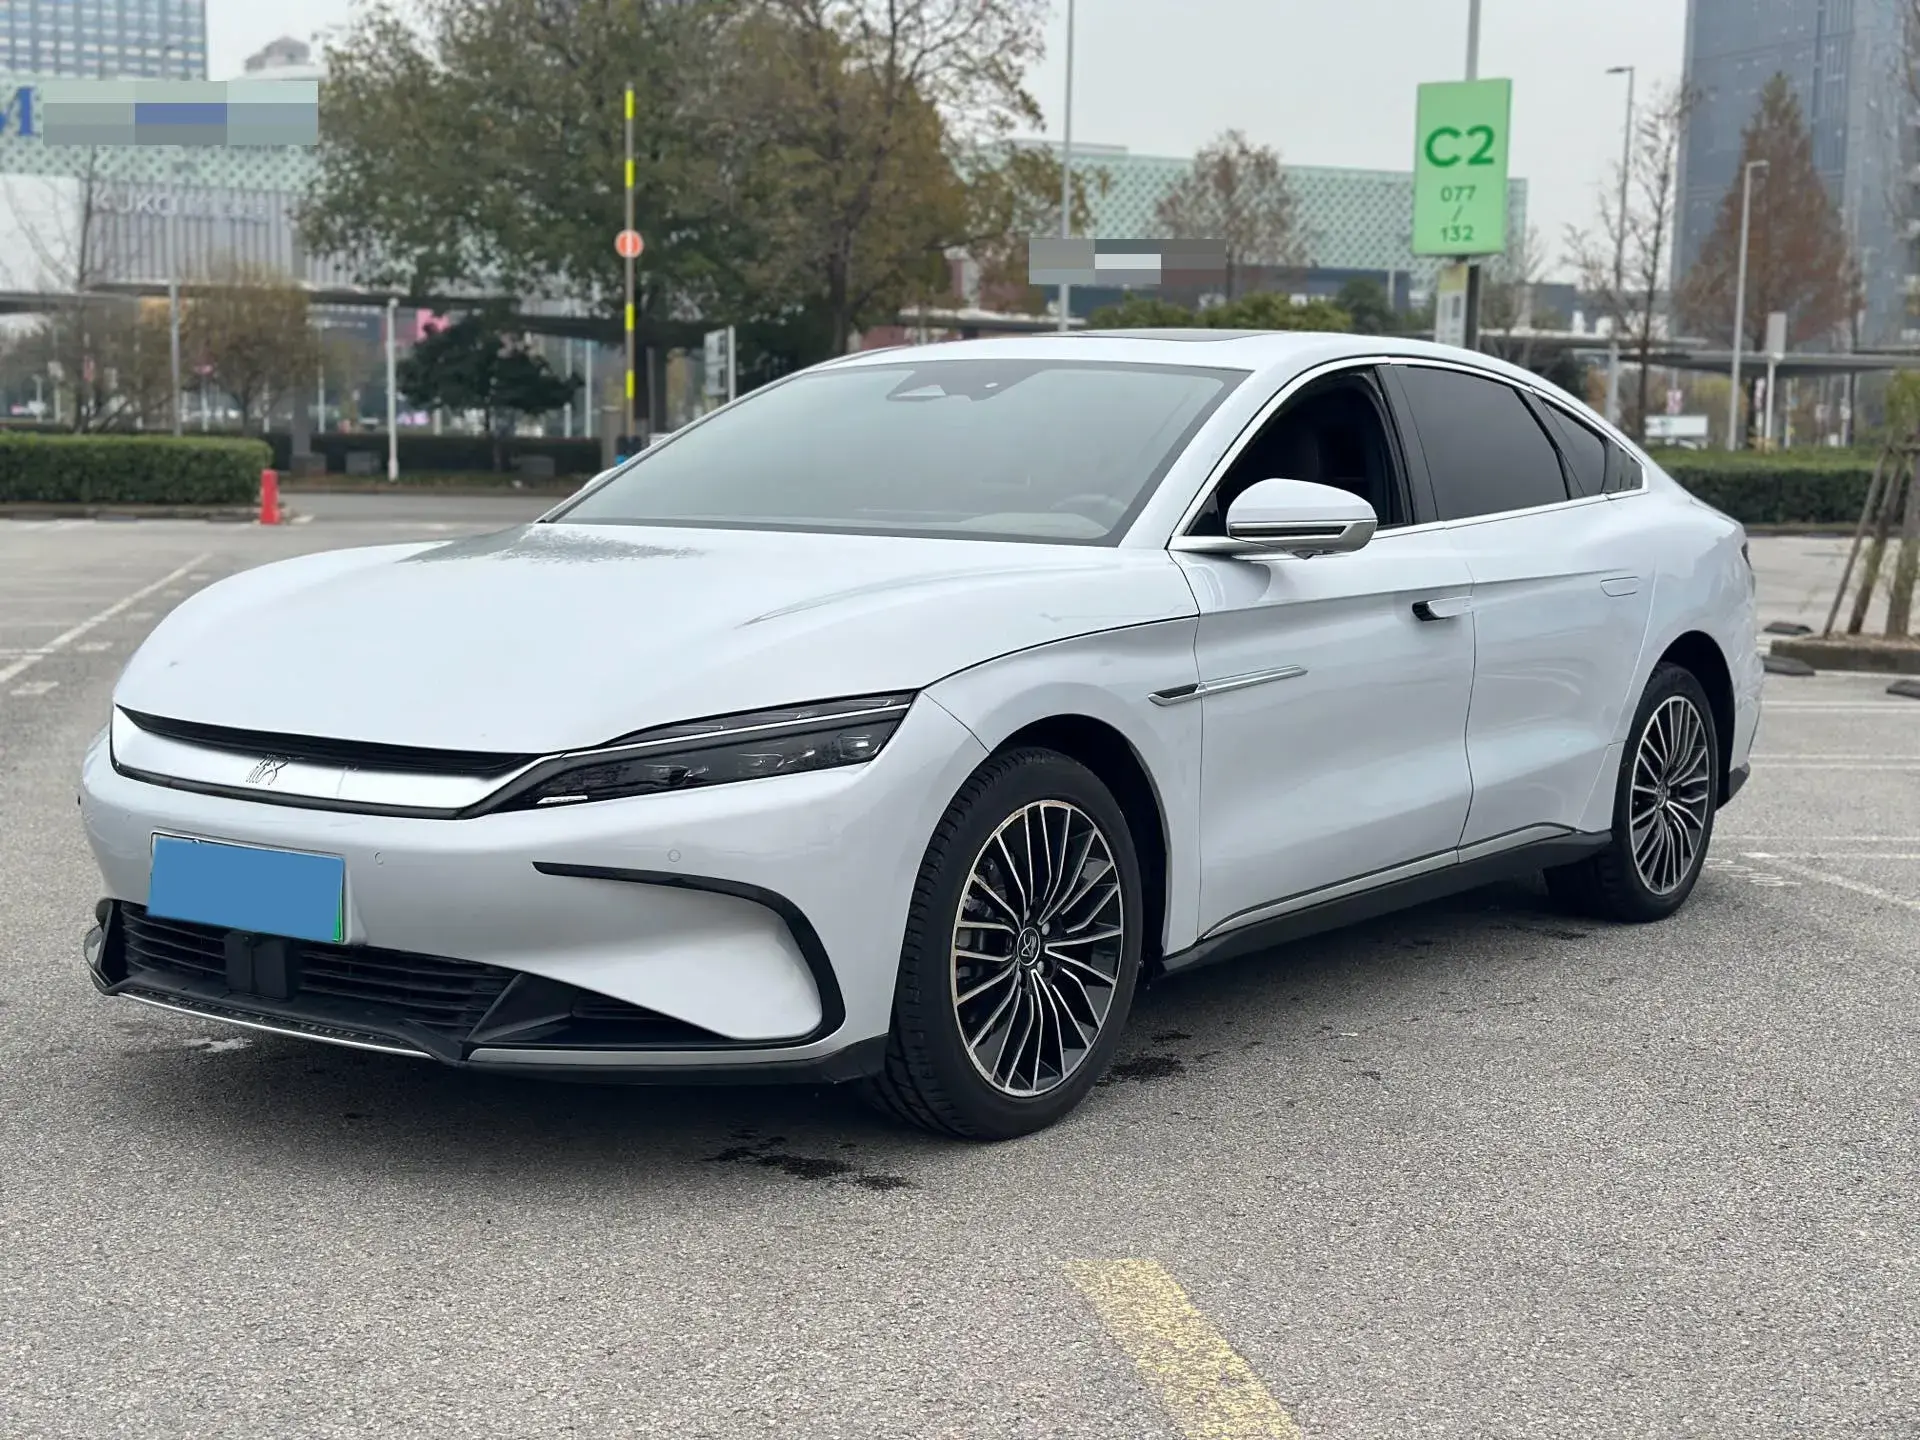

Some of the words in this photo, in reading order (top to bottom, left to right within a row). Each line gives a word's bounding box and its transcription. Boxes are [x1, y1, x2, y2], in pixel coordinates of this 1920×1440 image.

[1425, 125, 1495, 167] C2
[1440, 185, 1476, 203] 077
[1440, 226, 1475, 243] 132
